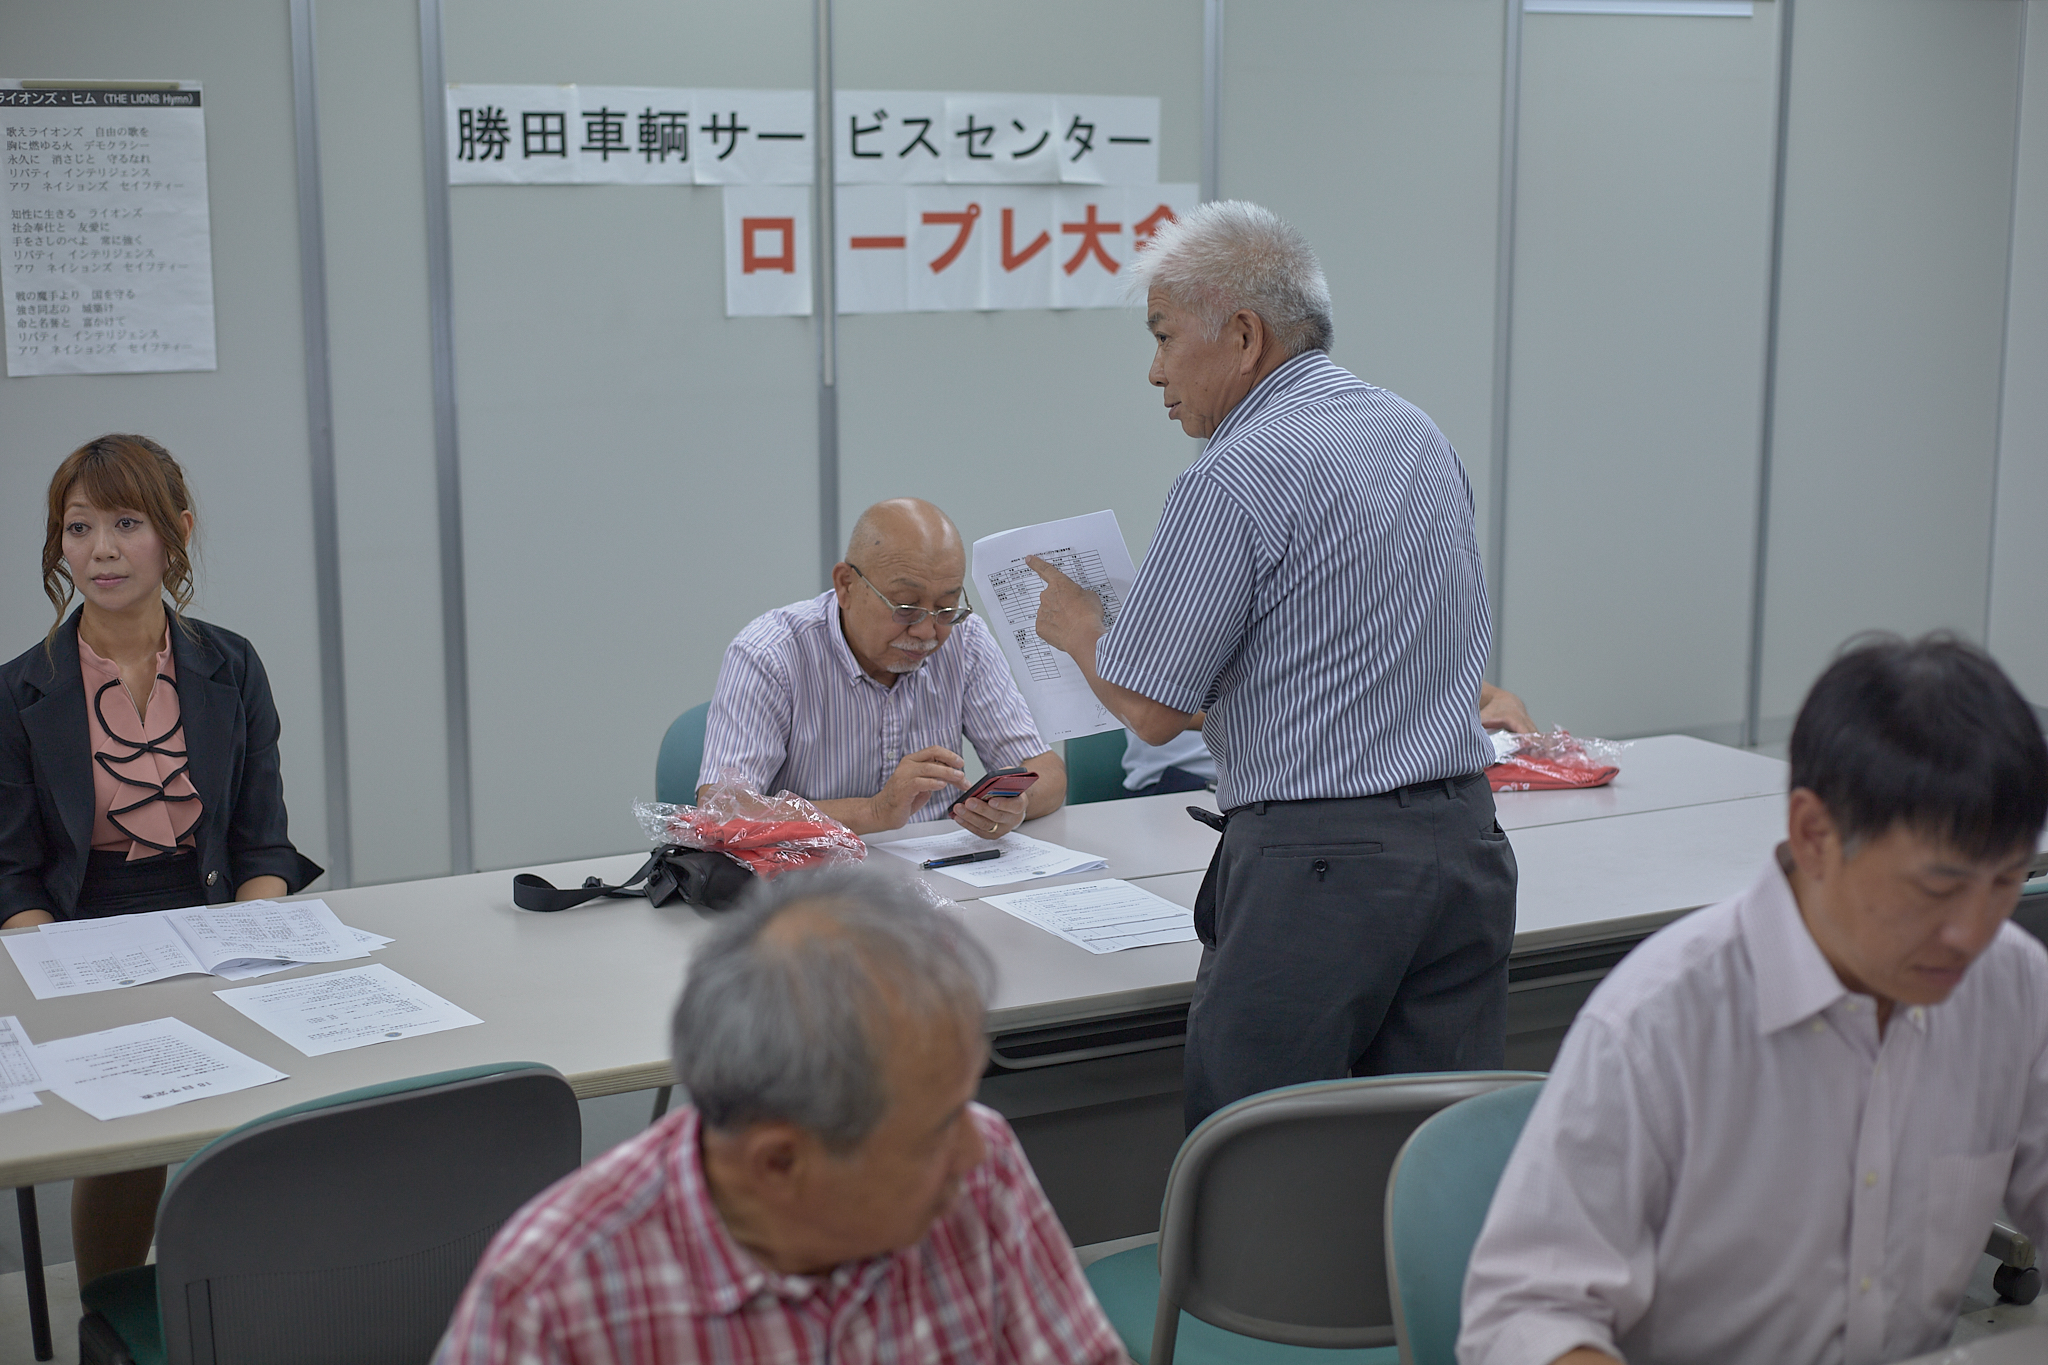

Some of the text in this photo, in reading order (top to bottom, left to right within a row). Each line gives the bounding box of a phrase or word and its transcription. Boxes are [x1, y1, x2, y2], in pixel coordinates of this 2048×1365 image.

[130, 93, 160, 105] LIONS
[6, 126, 149, 138] 歌えライオンズ 自由の歌を
[7, 140, 150, 151] 胸に燃ゆる火 デモクラシー
[8, 154, 151, 165] 永久に 消さじと 守るなれ
[64, 167, 151, 178] インテリジェンス
[10, 181, 184, 192] アワ ネイションズ セイフティー
[12, 207, 143, 220] 知性に生きる ライオンズ
[12, 222, 109, 233] 社会奉仕と 友愛に
[69, 248, 155, 259] インテリジェンス
[14, 262, 188, 273] アワ ネイションズ セイフティー
[74, 329, 160, 341] インテリジェンス
[19, 343, 192, 355] アワ ネイションズ セイフティー
